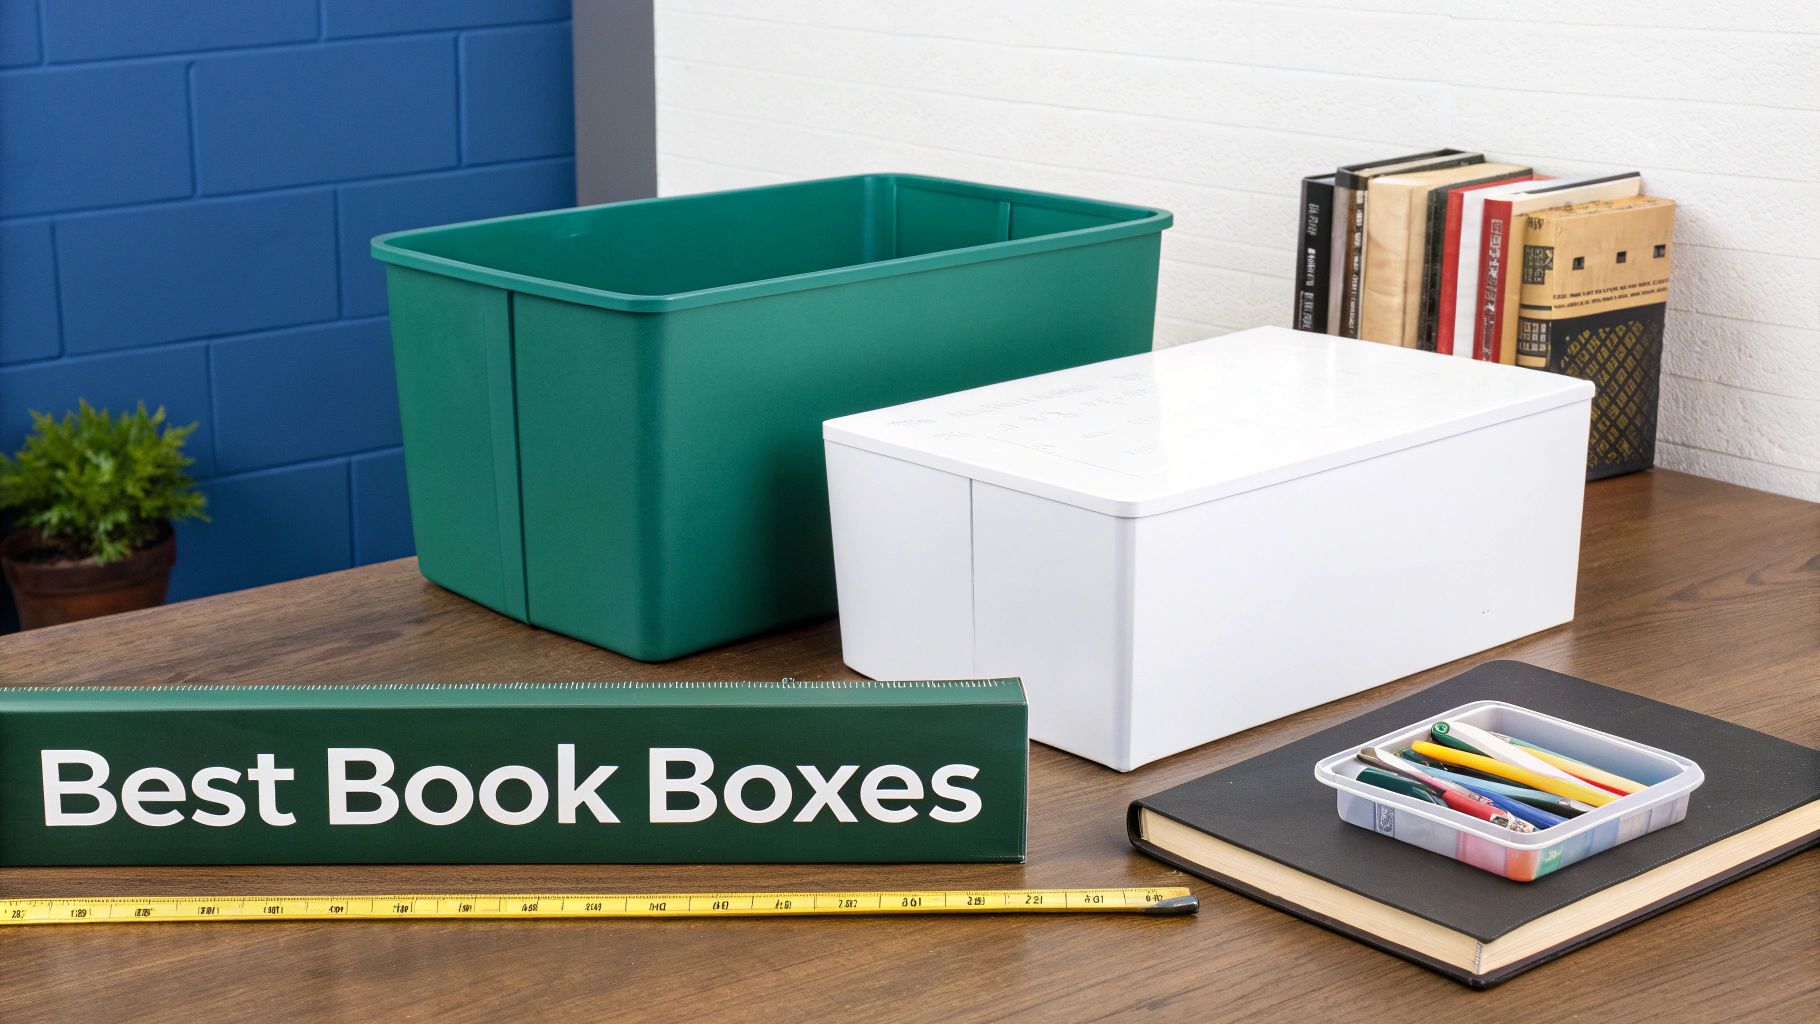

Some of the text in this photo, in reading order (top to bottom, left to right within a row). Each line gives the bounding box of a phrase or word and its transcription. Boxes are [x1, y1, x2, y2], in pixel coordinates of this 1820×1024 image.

[40, 743, 983, 827] Best Book Boxes
